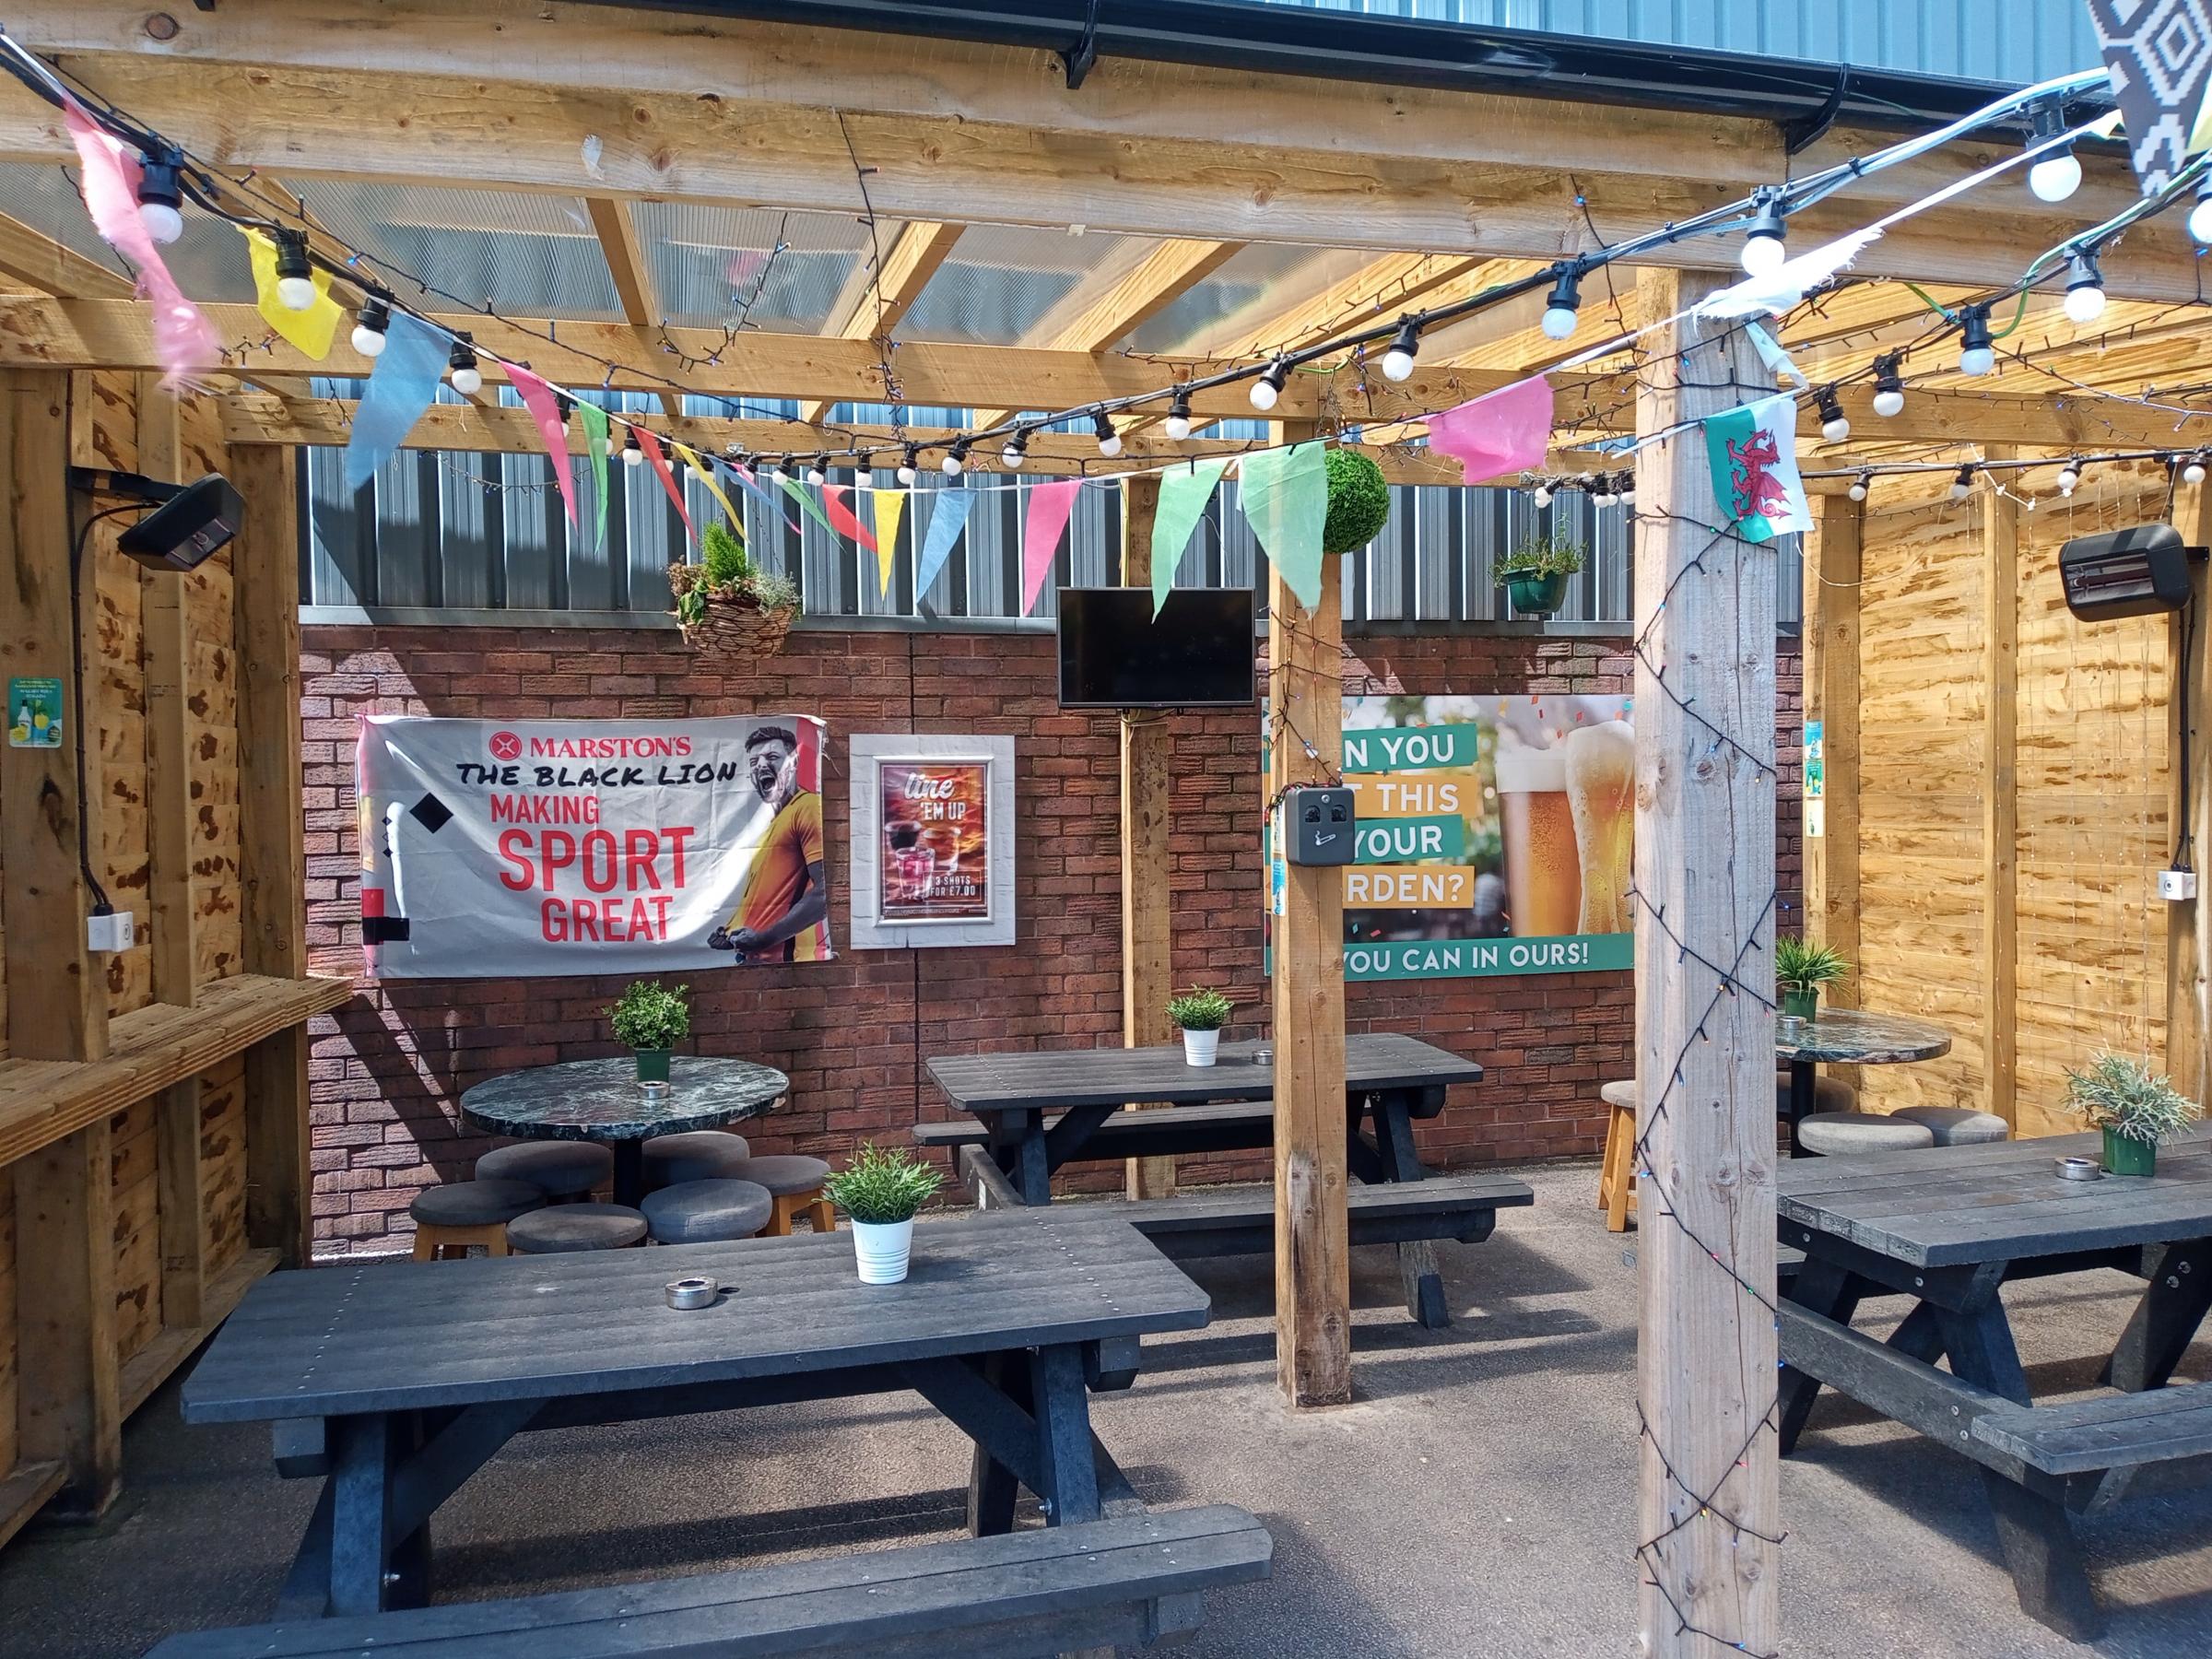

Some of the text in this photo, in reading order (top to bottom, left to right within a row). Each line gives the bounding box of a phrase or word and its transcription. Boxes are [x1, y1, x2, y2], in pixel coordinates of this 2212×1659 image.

[530, 736, 692, 759] MARSTON'S
[1380, 734, 1454, 766] YOU
[456, 761, 737, 788] THE BLACK LION
[904, 772, 955, 799] line
[490, 794, 600, 824] MAKING
[947, 802, 966, 820] UP
[1376, 782, 1460, 812] THIS
[498, 827, 695, 892] SPORT
[930, 886, 976, 897] FOR £7.00
[935, 876, 971, 886] 3 SHOTS
[1347, 874, 1465, 902] RDEN?
[541, 895, 673, 942] GREAT
[1344, 942, 1589, 973] OU CAN IN OURS!
